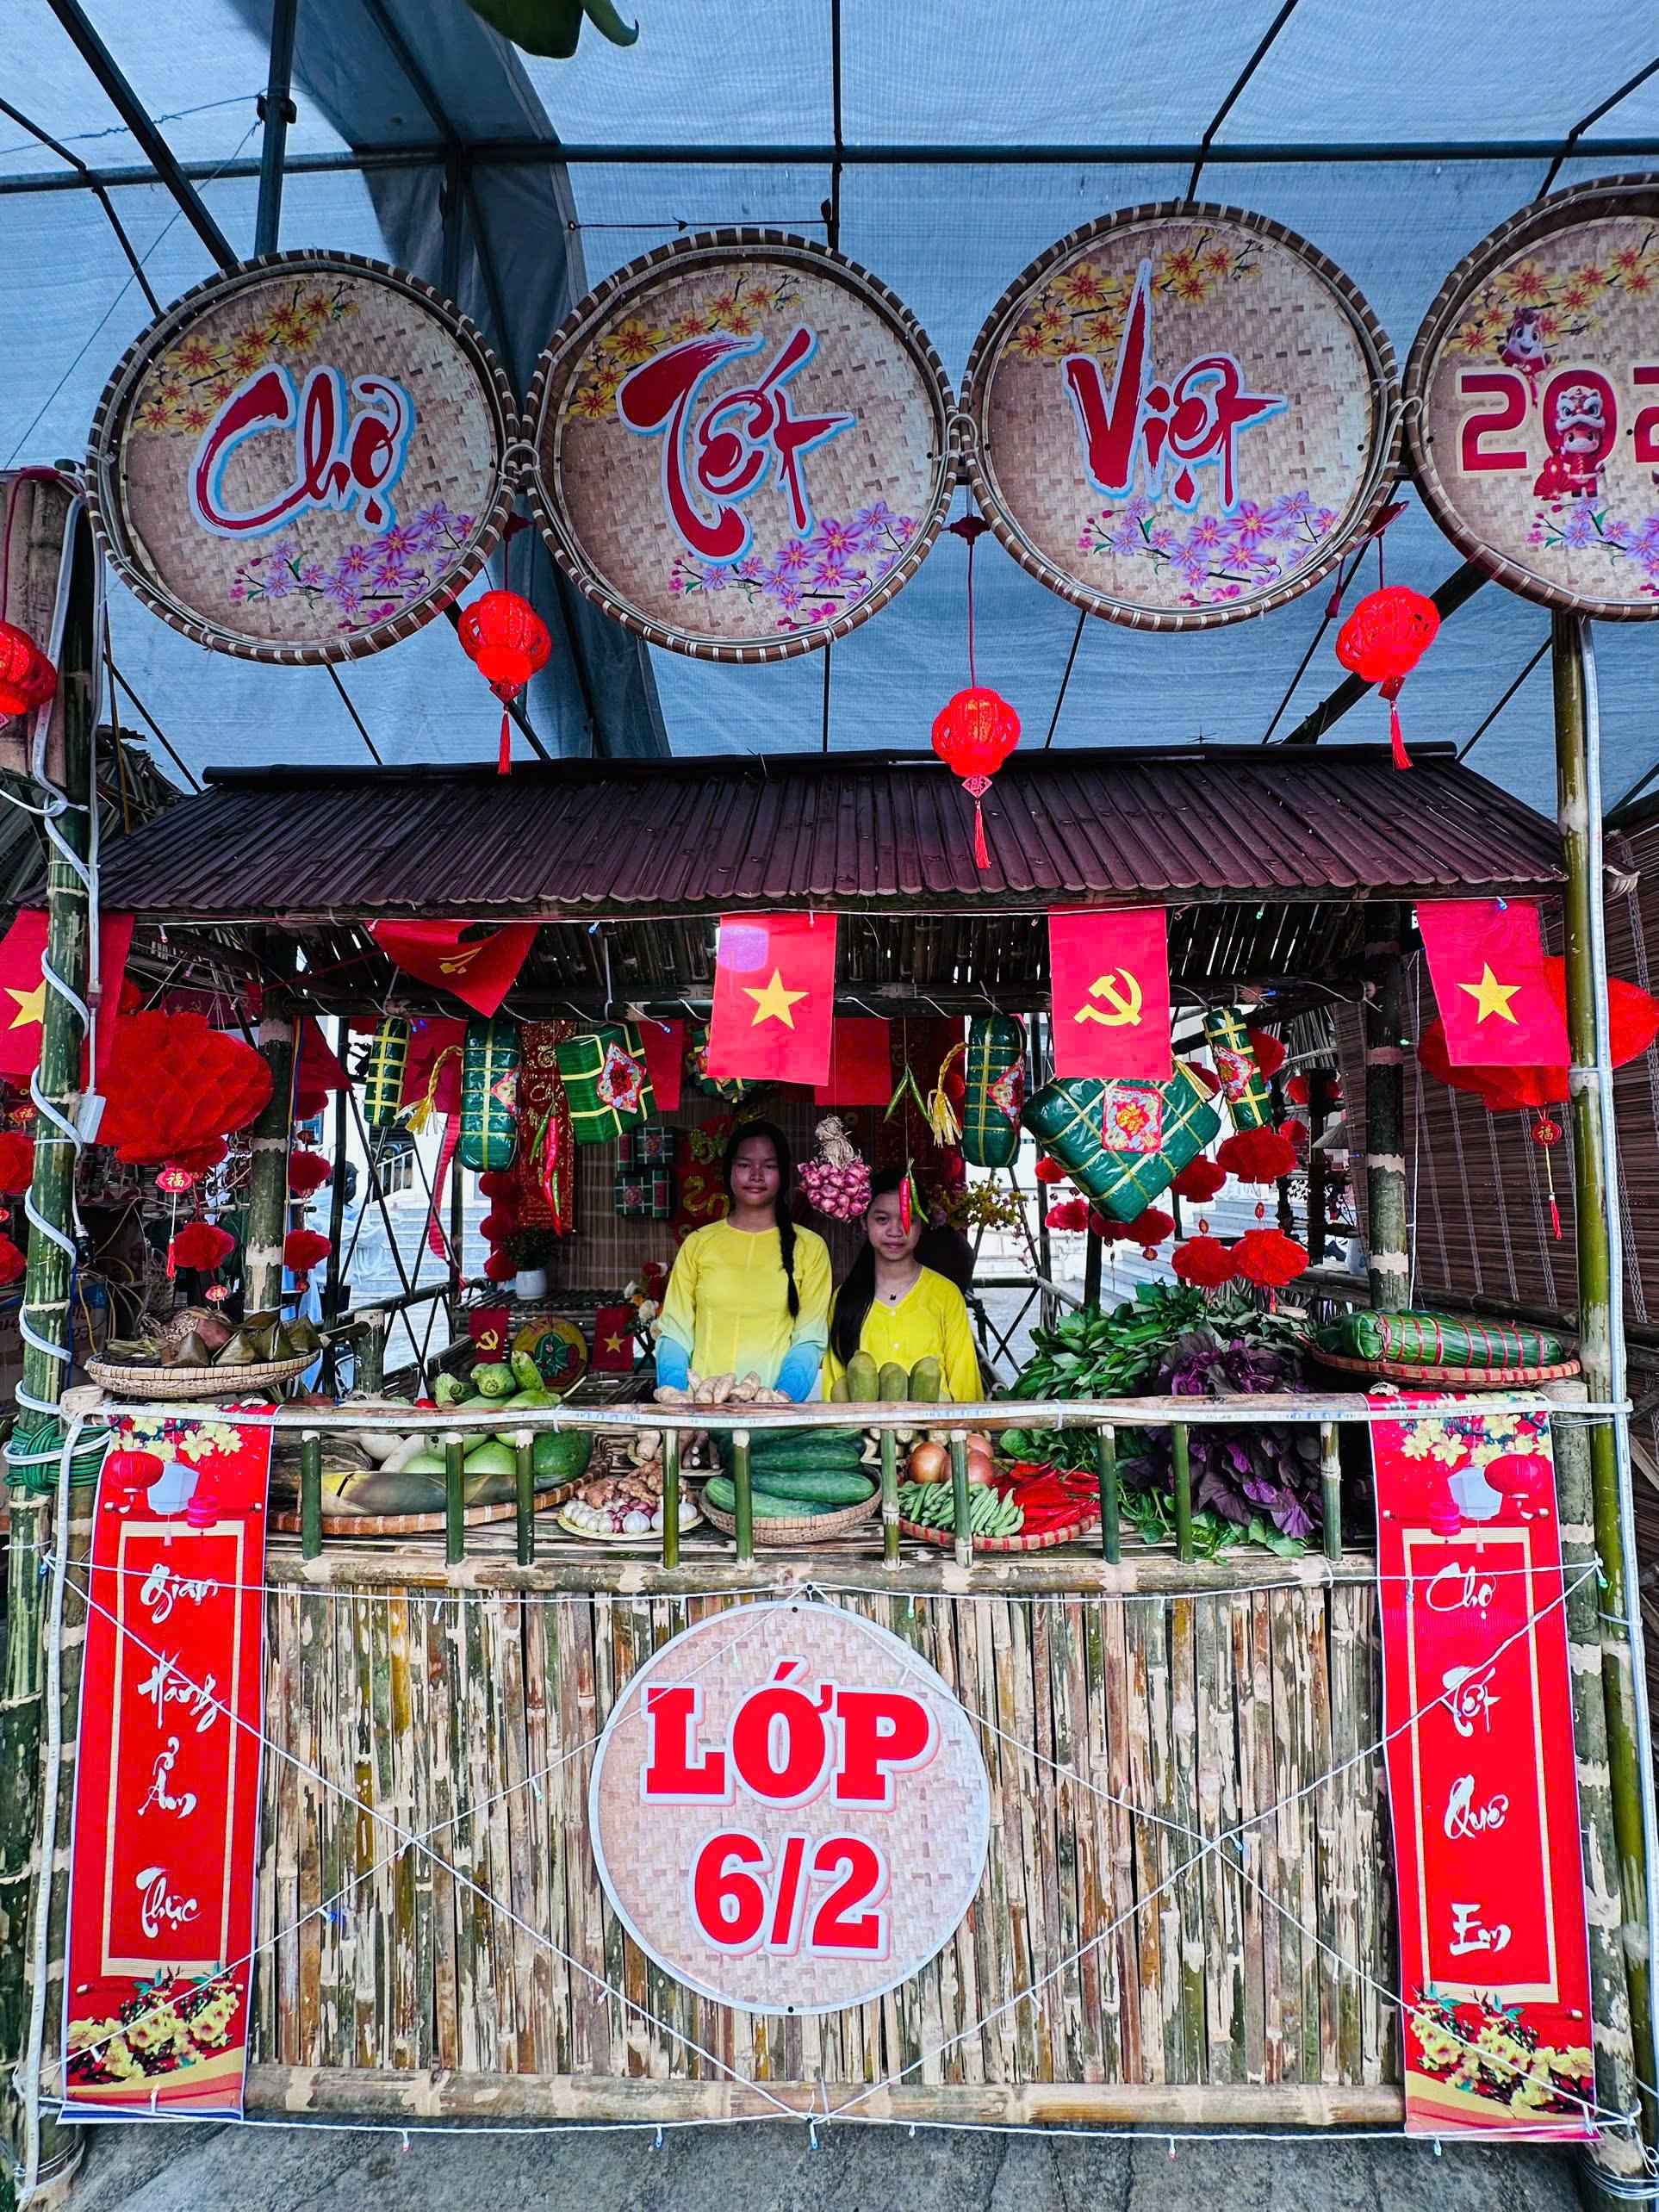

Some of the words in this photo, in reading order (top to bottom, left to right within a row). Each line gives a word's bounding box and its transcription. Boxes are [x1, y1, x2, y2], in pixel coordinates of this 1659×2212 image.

[195, 370, 403, 531] Chợ
[618, 326, 853, 559] Tết
[1065, 277, 1284, 509] Việt
[1538, 1124, 1554, 1141] 福
[165, 1171, 185, 1188] 福
[1426, 1561, 1498, 1620] Chợ
[644, 1659, 931, 1802] LỚP
[1441, 1665, 1502, 1737] Tết
[1443, 1773, 1509, 1840] Quê
[134, 1866, 202, 1938] Thực
[693, 1832, 880, 1951] 6/2
[1448, 1902, 1513, 1956] Em
